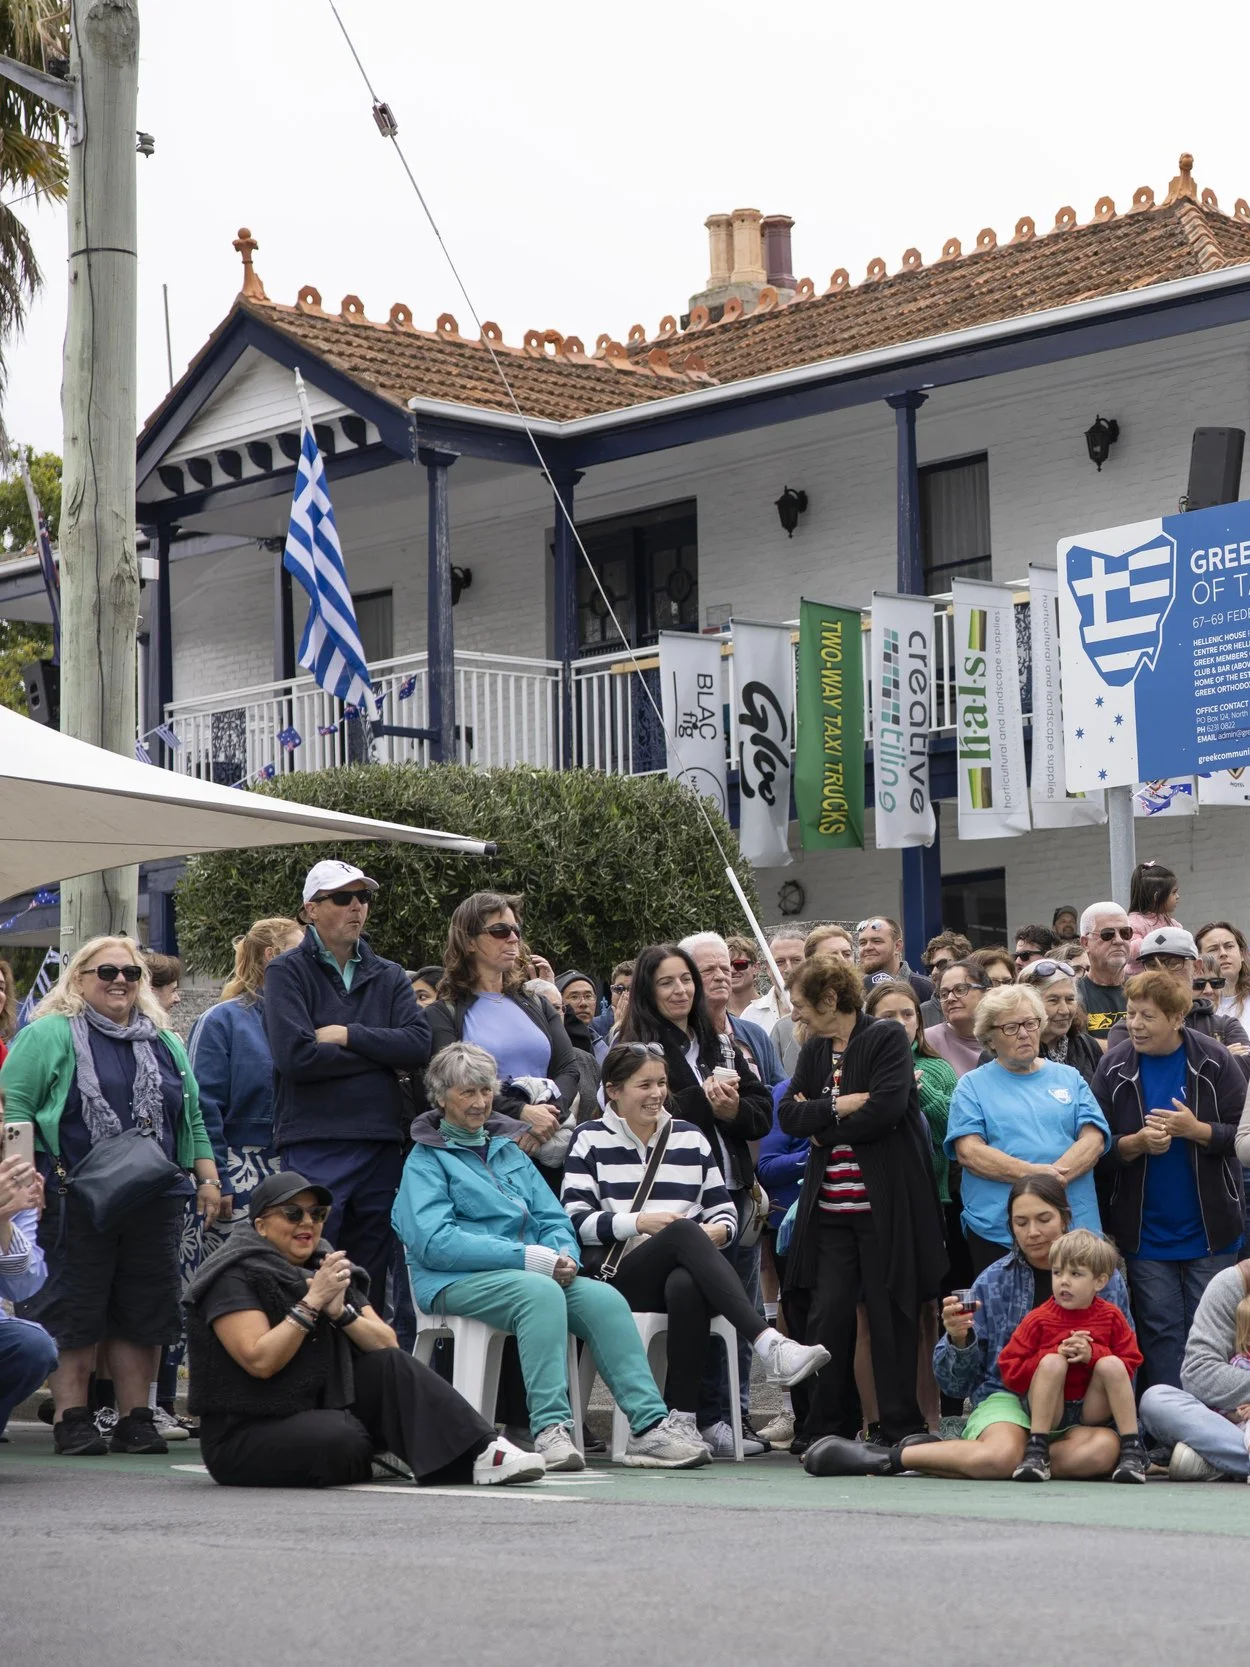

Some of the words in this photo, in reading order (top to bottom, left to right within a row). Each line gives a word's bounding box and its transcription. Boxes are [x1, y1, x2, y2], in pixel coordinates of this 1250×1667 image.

[1192, 577, 1225, 605] OF
[1193, 635, 1223, 647] HELLENIC
[1225, 631, 1246, 641] HOUSE
[1193, 646, 1218, 657] CENTRE
[1219, 644, 1232, 652] FOR
[1193, 657, 1215, 667] GREEK
[1216, 651, 1248, 663] MEMBERS
[820, 620, 842, 710] TWO-WAY
[1194, 668, 1211, 677] CLUB
[1217, 665, 1230, 673] BAR
[995, 658, 1005, 715] landscape
[1194, 677, 1214, 687] HOME
[1215, 675, 1225, 683] OF
[1226, 673, 1238, 681] THE
[1195, 687, 1216, 697] GREEK
[1196, 705, 1218, 715] OFFICE
[1219, 700, 1249, 711] CONTACT
[1231, 710, 1249, 719] North
[908, 630, 928, 815] creative
[998, 719, 1006, 740] and
[1046, 690, 1054, 750] landscape
[1197, 726, 1206, 734] PH
[1220, 721, 1235, 730] 0822
[824, 715, 842, 756] TAXI
[1197, 734, 1217, 743] EMAIL
[879, 727, 906, 813] tiling
[1000, 744, 1012, 808] horticultural
[1046, 754, 1056, 799] supplies
[818, 762, 848, 834] TRUCKS
